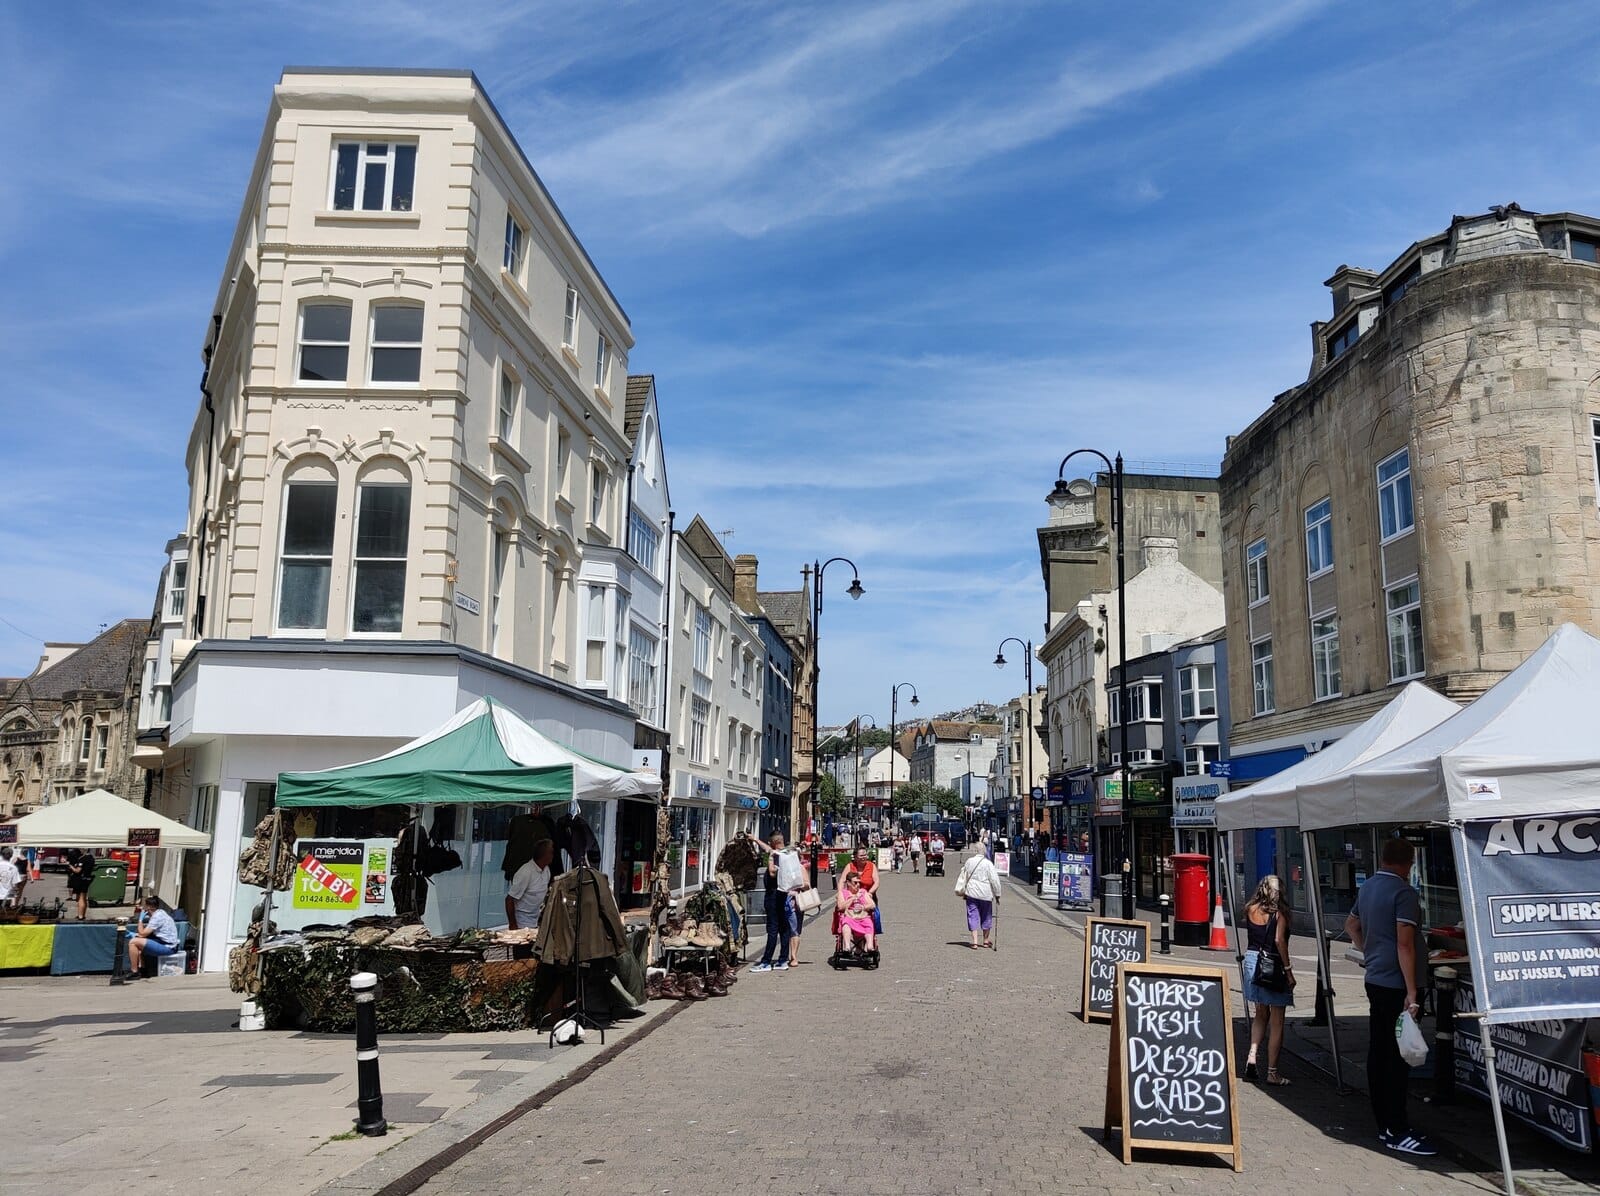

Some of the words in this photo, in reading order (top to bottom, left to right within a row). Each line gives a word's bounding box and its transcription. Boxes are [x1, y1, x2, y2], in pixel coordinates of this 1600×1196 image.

[1482, 816, 1600, 856] ARC
[301, 877, 323, 893] TO
[305, 857, 333, 883] LET
[329, 877, 353, 898] BY
[299, 895, 323, 903] 01424
[1500, 902, 1600, 924] SUPPLIERS
[1095, 924, 1137, 947] FRESH
[1091, 945, 1141, 963] DRESSED
[1494, 951, 1520, 964] FIND
[1522, 950, 1537, 961] US
[1539, 949, 1554, 961] AT
[1556, 947, 1600, 960] VARIOU
[1494, 970, 1519, 982] EAST
[1522, 966, 1566, 980] SUSSEX,
[1567, 965, 1599, 977] WEST
[1126, 975, 1204, 1010] SUPERB
[1137, 1005, 1203, 1040] FRESH
[1497, 1026, 1527, 1047] HASTINGS
[1128, 1036, 1225, 1078] DRESSED
[1496, 1049, 1538, 1084] SHELLFISH
[1538, 1063, 1571, 1096] DAILY
[1133, 1072, 1225, 1116] CRABS
